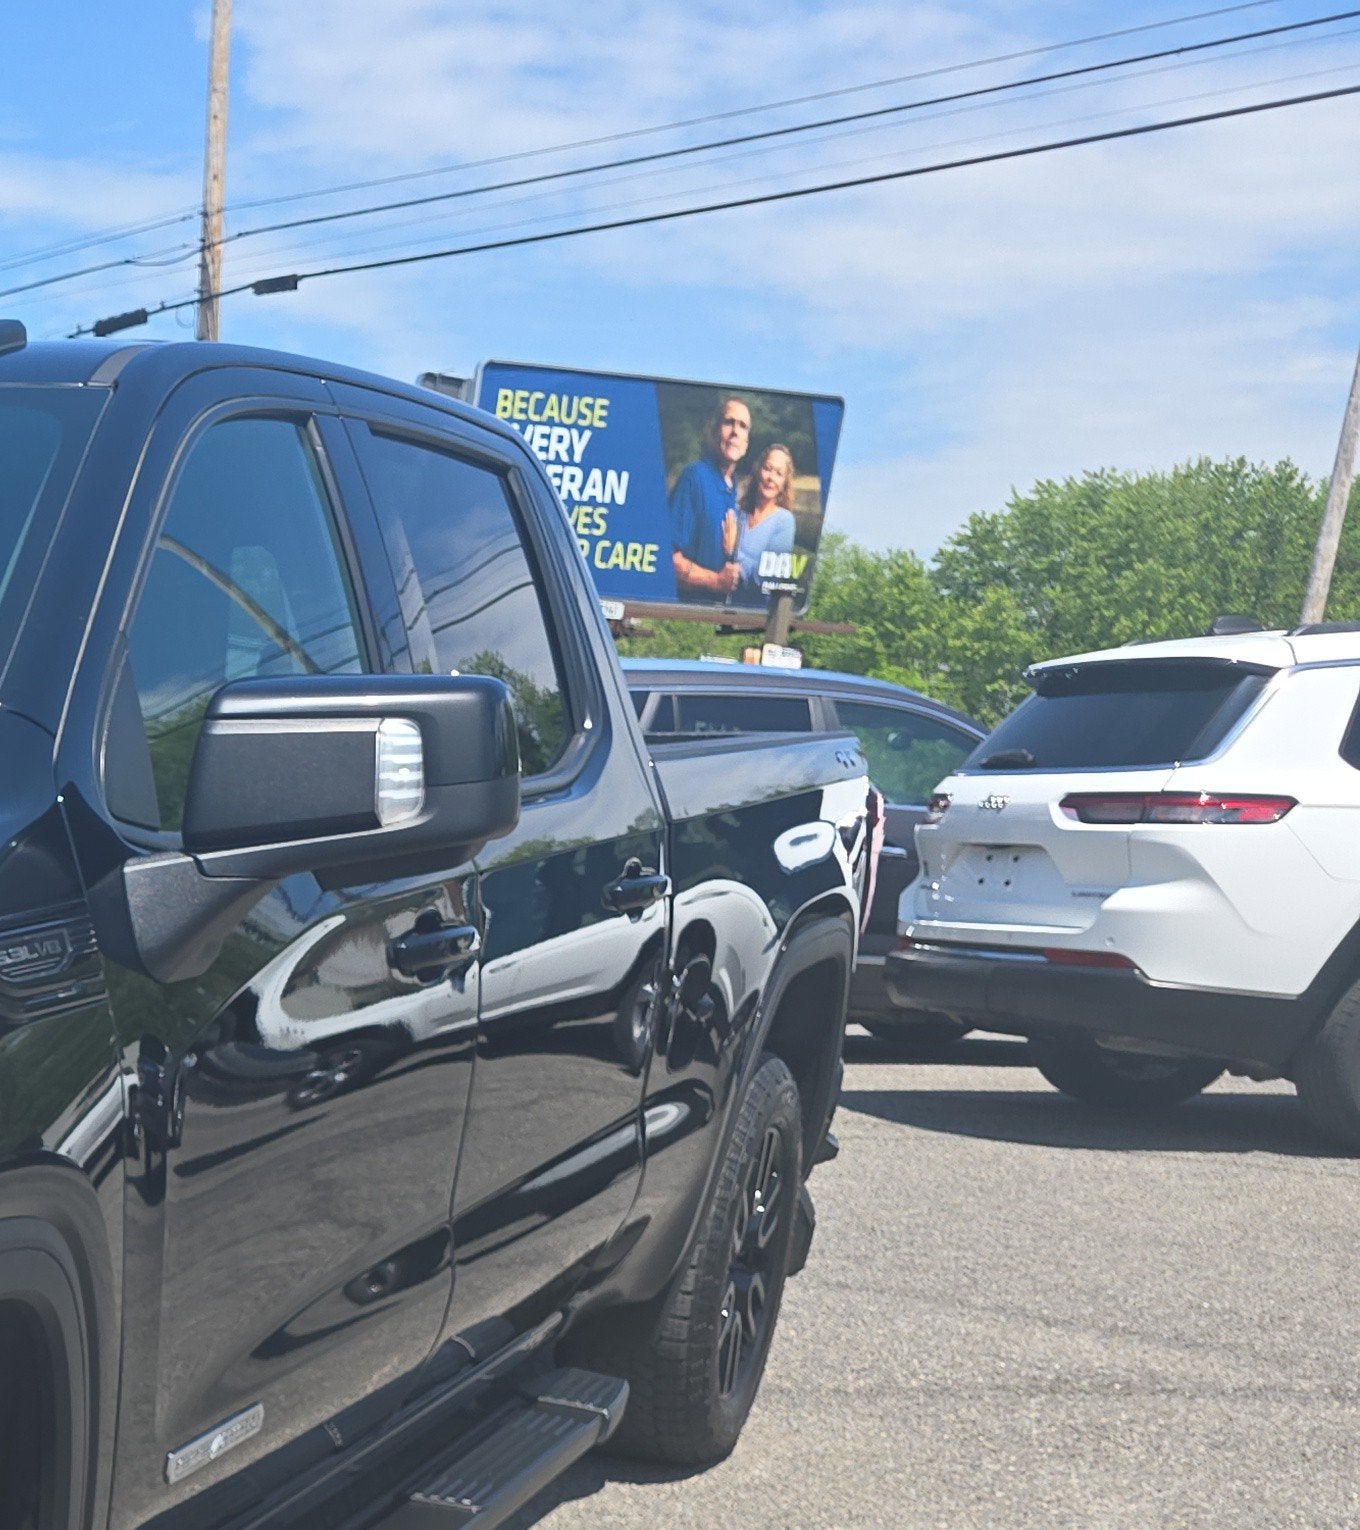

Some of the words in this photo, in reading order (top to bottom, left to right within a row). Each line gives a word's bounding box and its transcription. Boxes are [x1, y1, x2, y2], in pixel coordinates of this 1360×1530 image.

[495, 388, 610, 428] BECAUSE
[545, 464, 629, 505] ERAN
[594, 540, 660, 573] CARE
[759, 551, 808, 579] DAV
